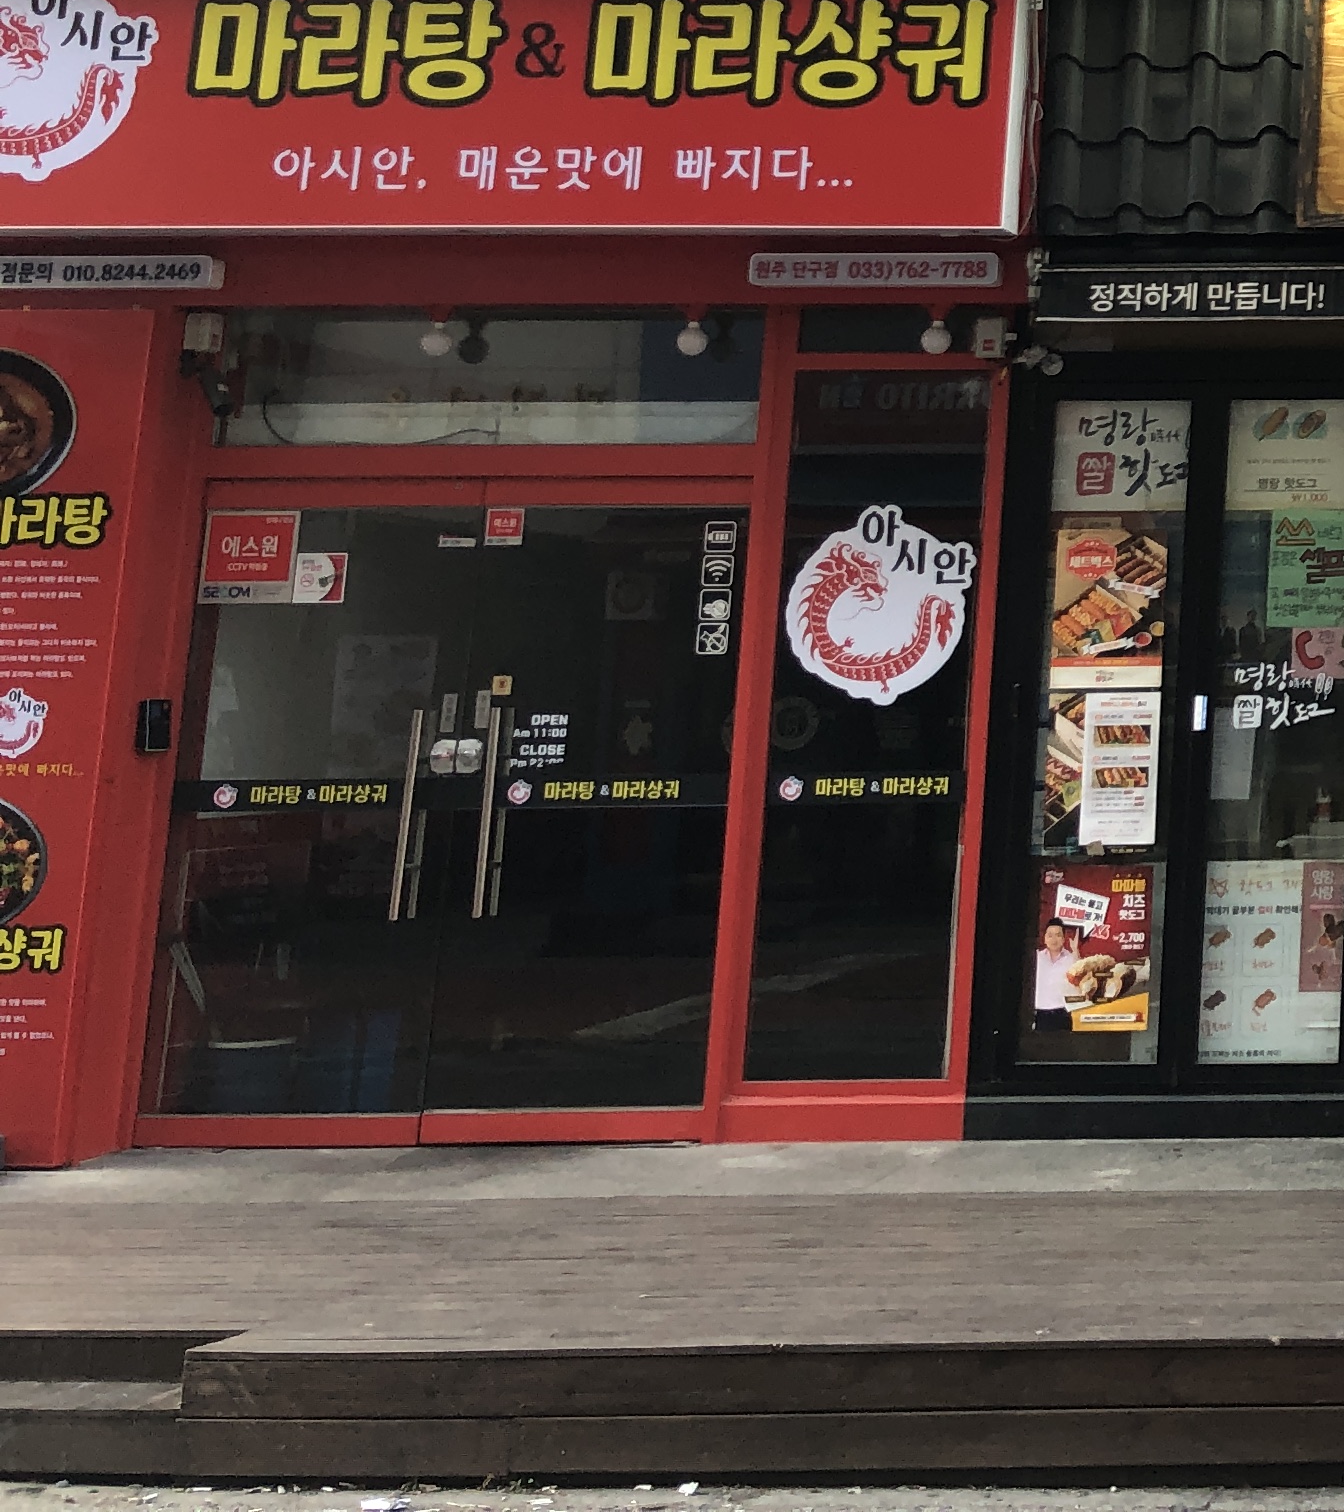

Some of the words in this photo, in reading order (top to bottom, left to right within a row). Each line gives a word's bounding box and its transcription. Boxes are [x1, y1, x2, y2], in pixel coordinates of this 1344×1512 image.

[516, 19, 567, 80] &
[272, 145, 427, 193] 아시안,
[458, 145, 644, 193] 매운맛에
[62, 262, 202, 283] 010.8244.2469
[755, 260, 787, 280] 원주
[848, 260, 988, 282] 033)762-7788
[1088, 280, 1200, 313] 정직하게
[1206, 280, 1326, 313] 만듭니다!
[1079, 407, 1160, 447] 명랑
[1080, 456, 1113, 492] 쌀
[1284, 477, 1318, 490] 핫도그
[221, 534, 280, 558] 에스원
[862, 509, 971, 585] 아시안
[1234, 660, 1298, 690] 명랑
[530, 714, 569, 726] OPEN
[533, 727, 568, 739] 11:00
[519, 744, 566, 757] CLOSE
[249, 784, 302, 805] 마라탕
[318, 783, 388, 805] 마라샹궈
[543, 781, 595, 801] 마라탕
[611, 778, 681, 800] 마라샹궈
[815, 777, 866, 797] 마라탕
[882, 776, 950, 796] 마라샹궈
[1122, 894, 1146, 909] 치즈
[1118, 908, 1146, 921] 핫도그
